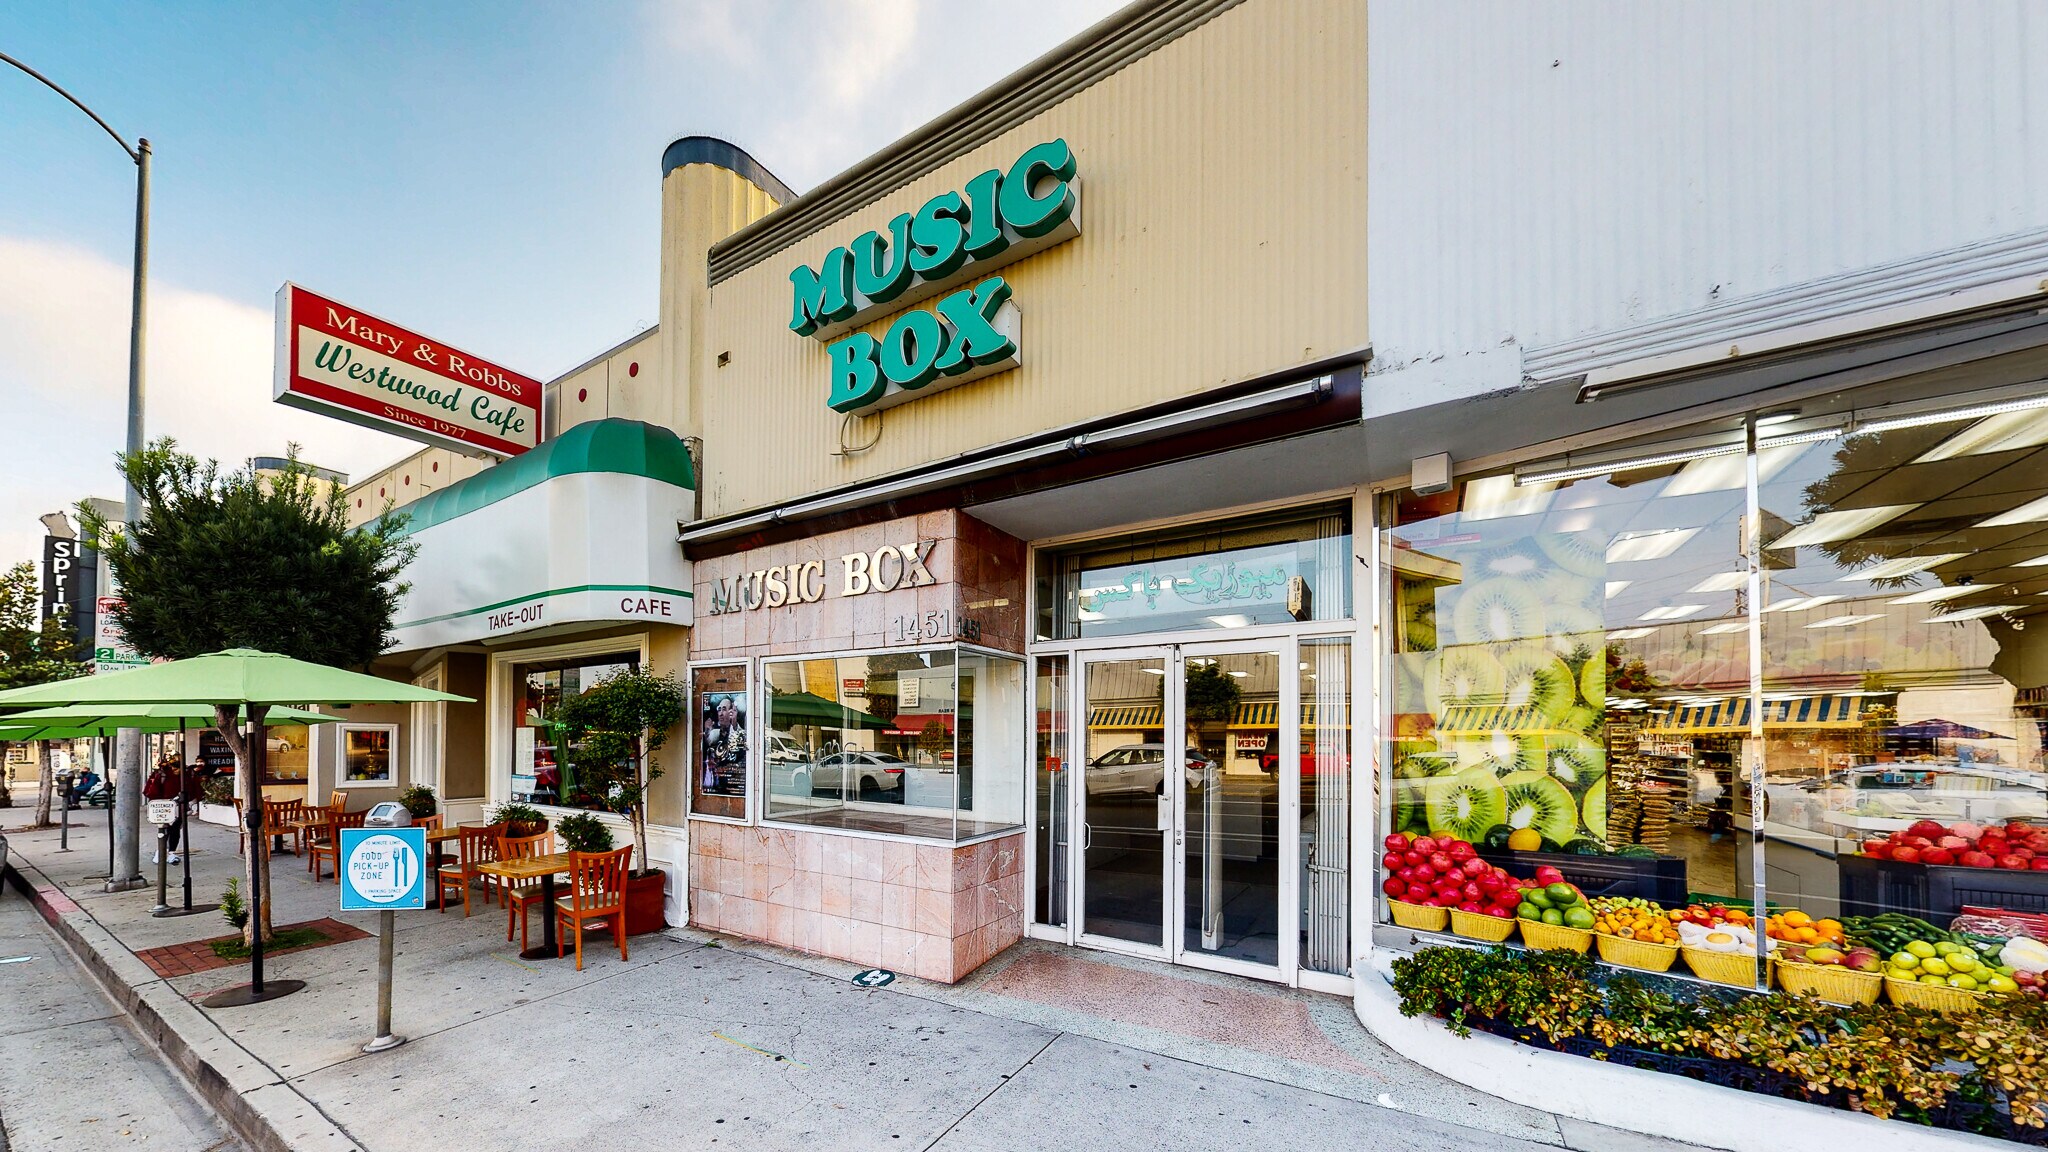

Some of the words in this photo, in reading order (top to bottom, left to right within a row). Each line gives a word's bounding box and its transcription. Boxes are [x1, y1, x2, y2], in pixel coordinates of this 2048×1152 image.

[789, 138, 1077, 338] MUSIC
[326, 306, 403, 354] Mary
[413, 342, 438, 366] &
[448, 353, 522, 396] Robbs
[827, 276, 1017, 413] BOX
[315, 341, 462, 411] Westwood
[470, 395, 525, 435] Cafe
[384, 406, 426, 427] Since
[433, 420, 467, 438] 1977
[710, 559, 825, 615] MUSIC
[842, 540, 937, 597] BOX
[488, 604, 544, 631] TAKE-OUT
[621, 598, 671, 616] CAFE
[894, 609, 952, 641] 1451
[100, 648, 111, 659] 2
[209, 746, 232, 754] WAXIN
[353, 862, 390, 870] PICK-UP
[361, 852, 382, 861] FOOD
[360, 872, 383, 880] ZONE
